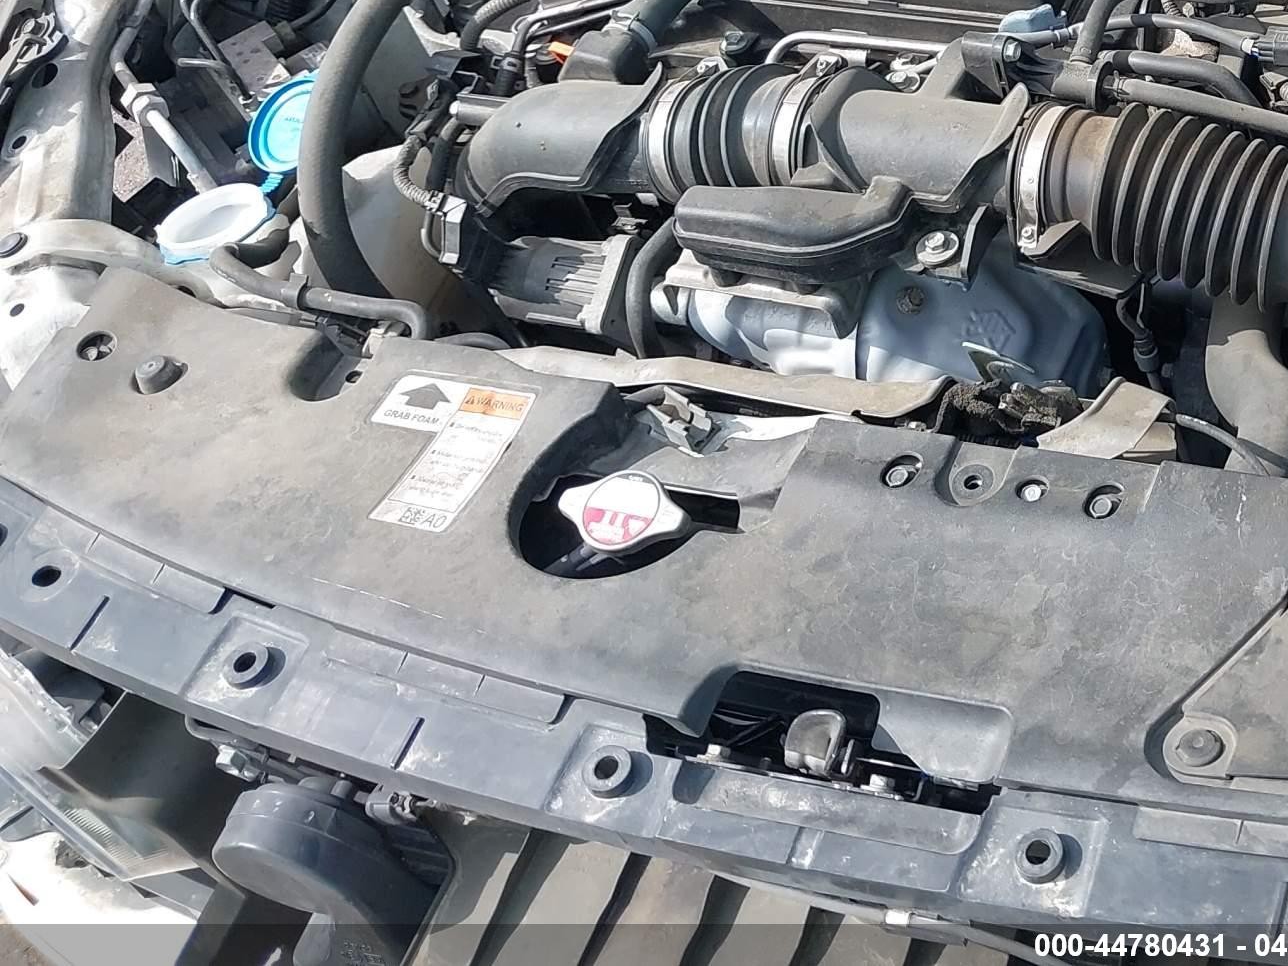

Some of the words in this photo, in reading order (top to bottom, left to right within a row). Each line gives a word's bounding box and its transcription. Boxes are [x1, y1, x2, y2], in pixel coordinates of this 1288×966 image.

[475, 396, 525, 412] WARNING
[384, 409, 411, 421] GRAB
[411, 413, 440, 425] FOAM
